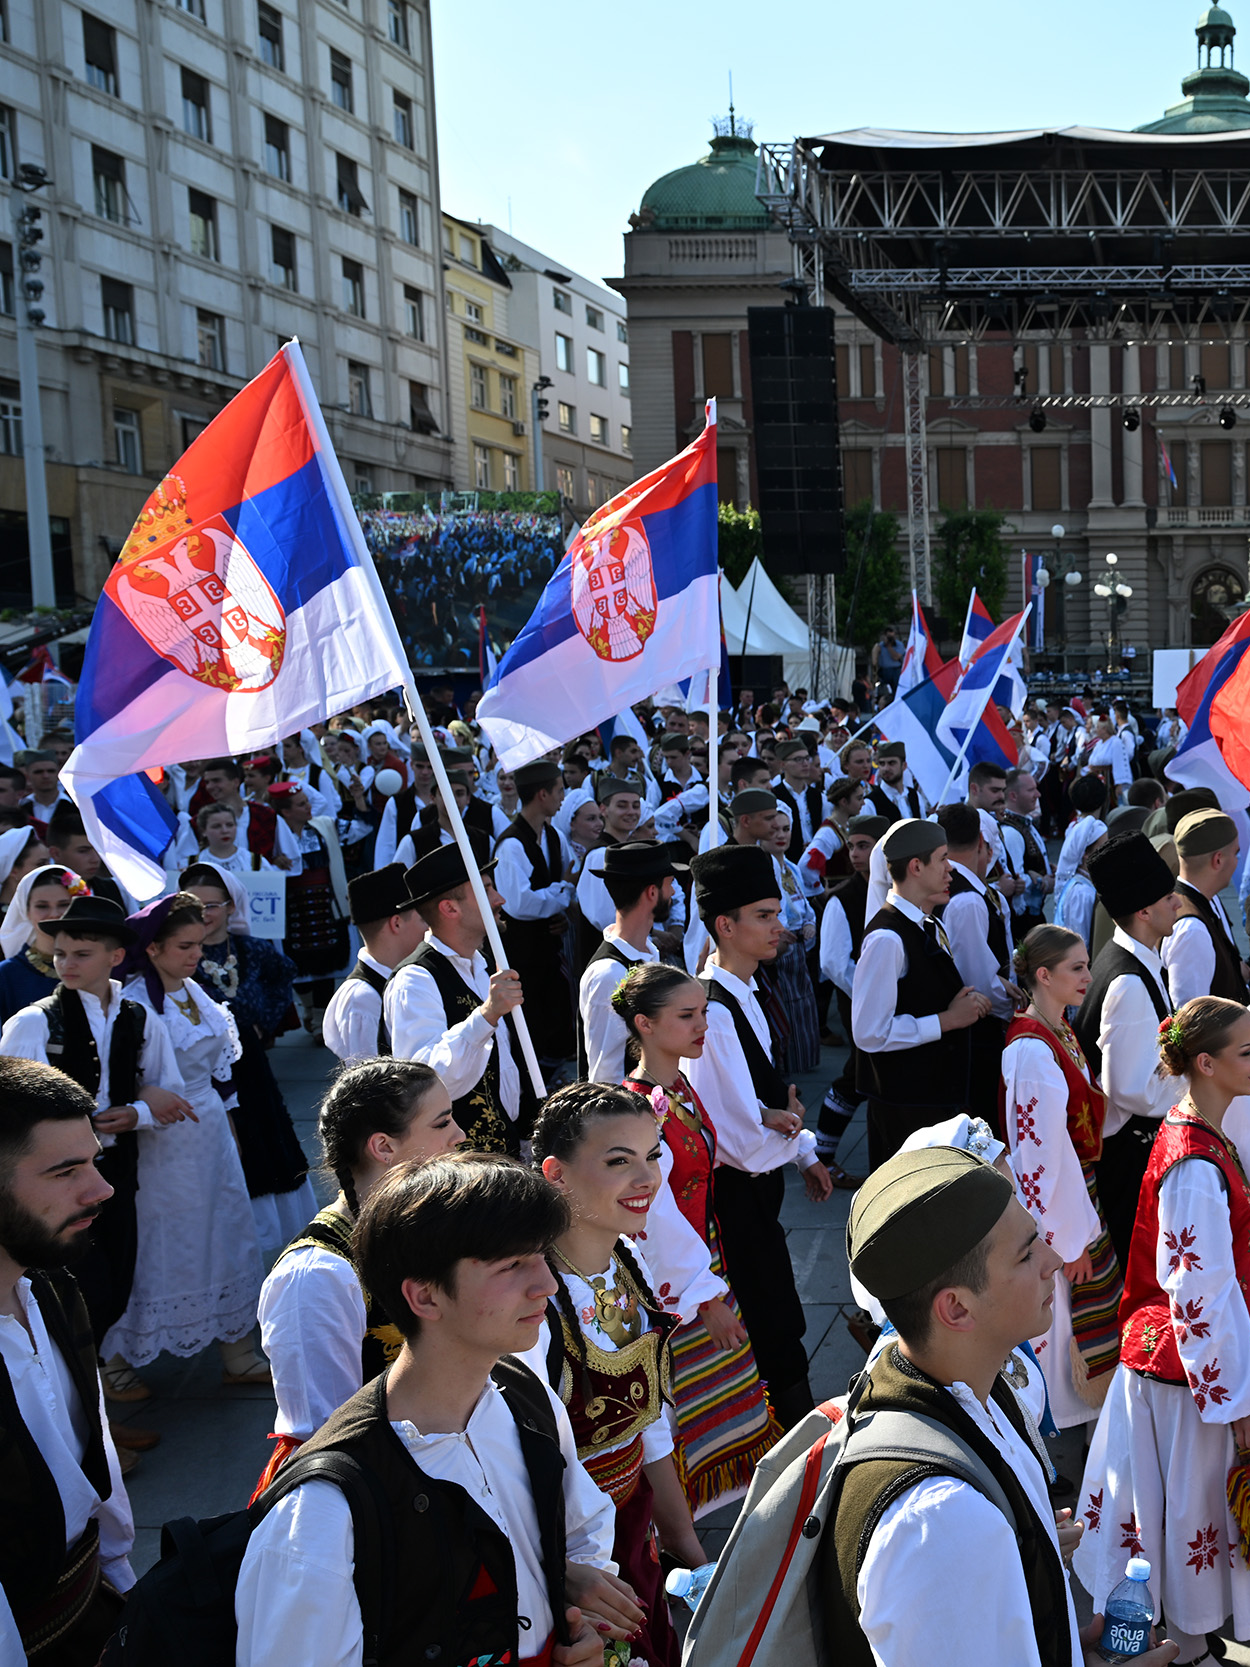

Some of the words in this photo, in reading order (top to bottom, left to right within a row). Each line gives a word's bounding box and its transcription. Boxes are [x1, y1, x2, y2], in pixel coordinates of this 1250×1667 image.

[250, 896, 281, 915] СТ
[1110, 1625, 1145, 1642] aqua
[1111, 1636, 1141, 1653] viva
